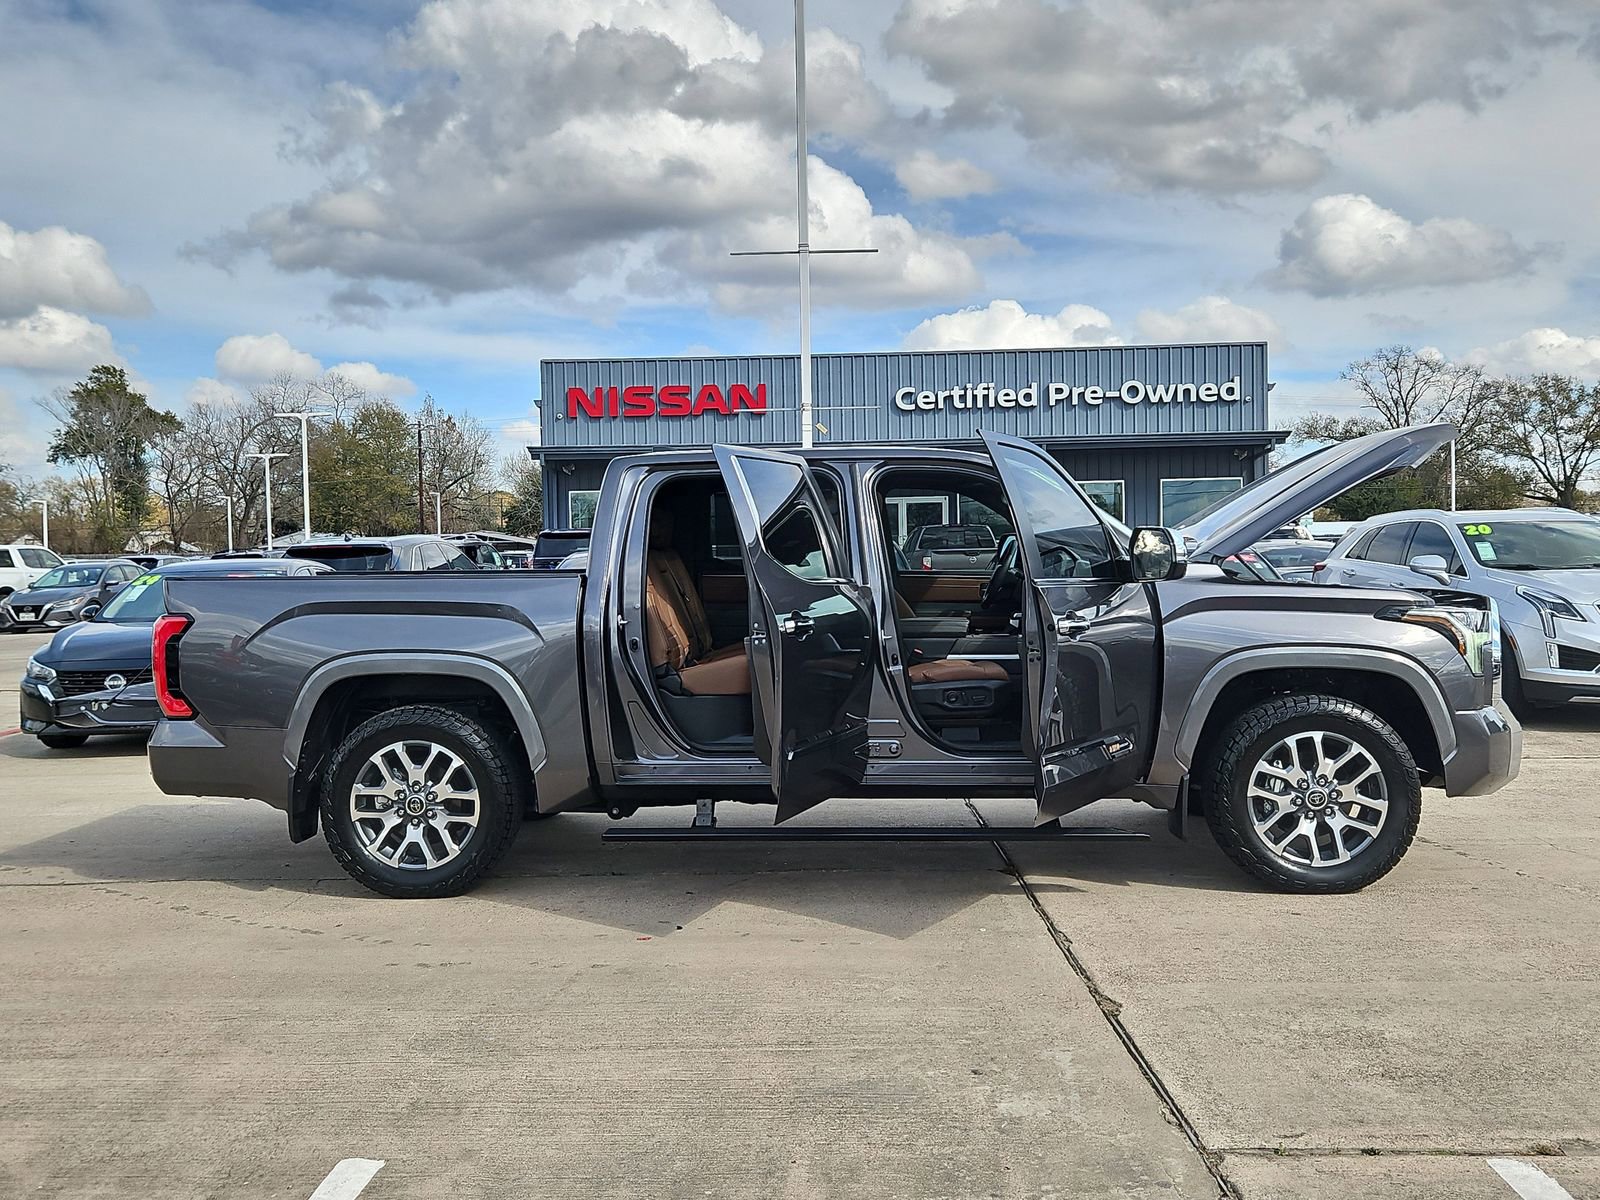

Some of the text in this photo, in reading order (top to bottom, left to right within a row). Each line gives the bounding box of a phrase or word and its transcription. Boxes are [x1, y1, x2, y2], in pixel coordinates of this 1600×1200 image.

[567, 384, 767, 418] NISSAN
[895, 376, 1241, 411] Certified Pre-Owned
[1463, 524, 1493, 536] 20
